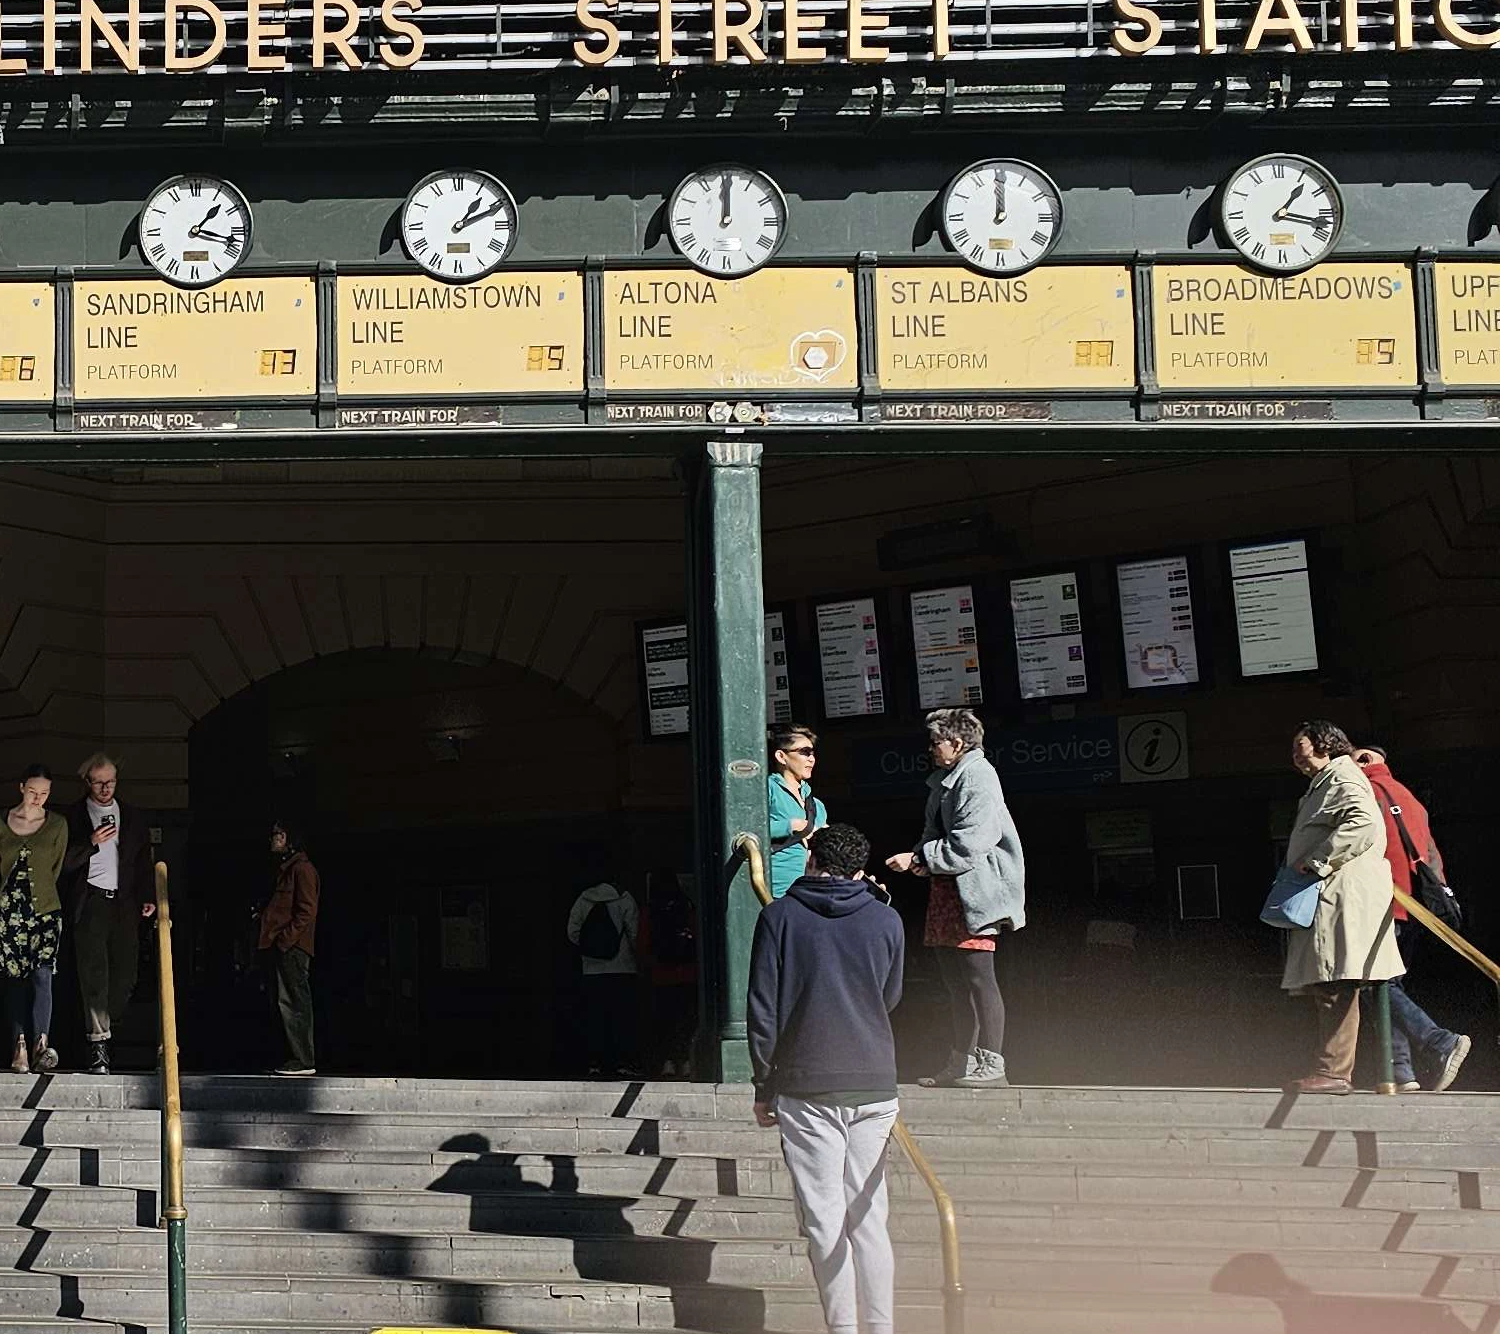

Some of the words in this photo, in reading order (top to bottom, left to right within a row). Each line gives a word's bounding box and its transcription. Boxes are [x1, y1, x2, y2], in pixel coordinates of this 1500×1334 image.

[353, 285, 541, 310] WILLIAMSTOWN
[619, 281, 717, 306] ALTONA
[891, 281, 921, 304] ST
[929, 280, 1028, 303] ALBANS
[1168, 276, 1393, 302] BROADMEADOWS
[87, 291, 264, 316] SANDRINGHAM
[352, 321, 404, 344] LINE
[619, 315, 672, 338] LINE
[892, 315, 946, 337] LINE
[1170, 313, 1225, 336] LINE
[87, 326, 138, 349] LINE
[351, 359, 443, 375] PLATFORM
[620, 354, 713, 370] PLATFORM
[893, 354, 987, 369] PLATFORM
[1171, 351, 1269, 368] PLATFORM
[87, 364, 177, 380] PLATFORM
[80, 415, 116, 427] NEXT
[120, 414, 162, 427] TRAIN
[167, 414, 194, 426] FOR
[341, 411, 376, 423] NEXT
[381, 410, 425, 423] TRAIN
[430, 409, 458, 422] FOR
[607, 406, 635, 419] NEXT
[639, 405, 674, 418] TRAIN
[678, 405, 703, 417] FOR
[886, 405, 923, 418] NEXT
[928, 405, 973, 418] TRAIN
[978, 405, 1006, 418] FOR
[1163, 405, 1201, 417] NEXT
[1205, 404, 1251, 417] TRAIN
[1256, 404, 1285, 416] FOR
[1011, 735, 1113, 765] Service
